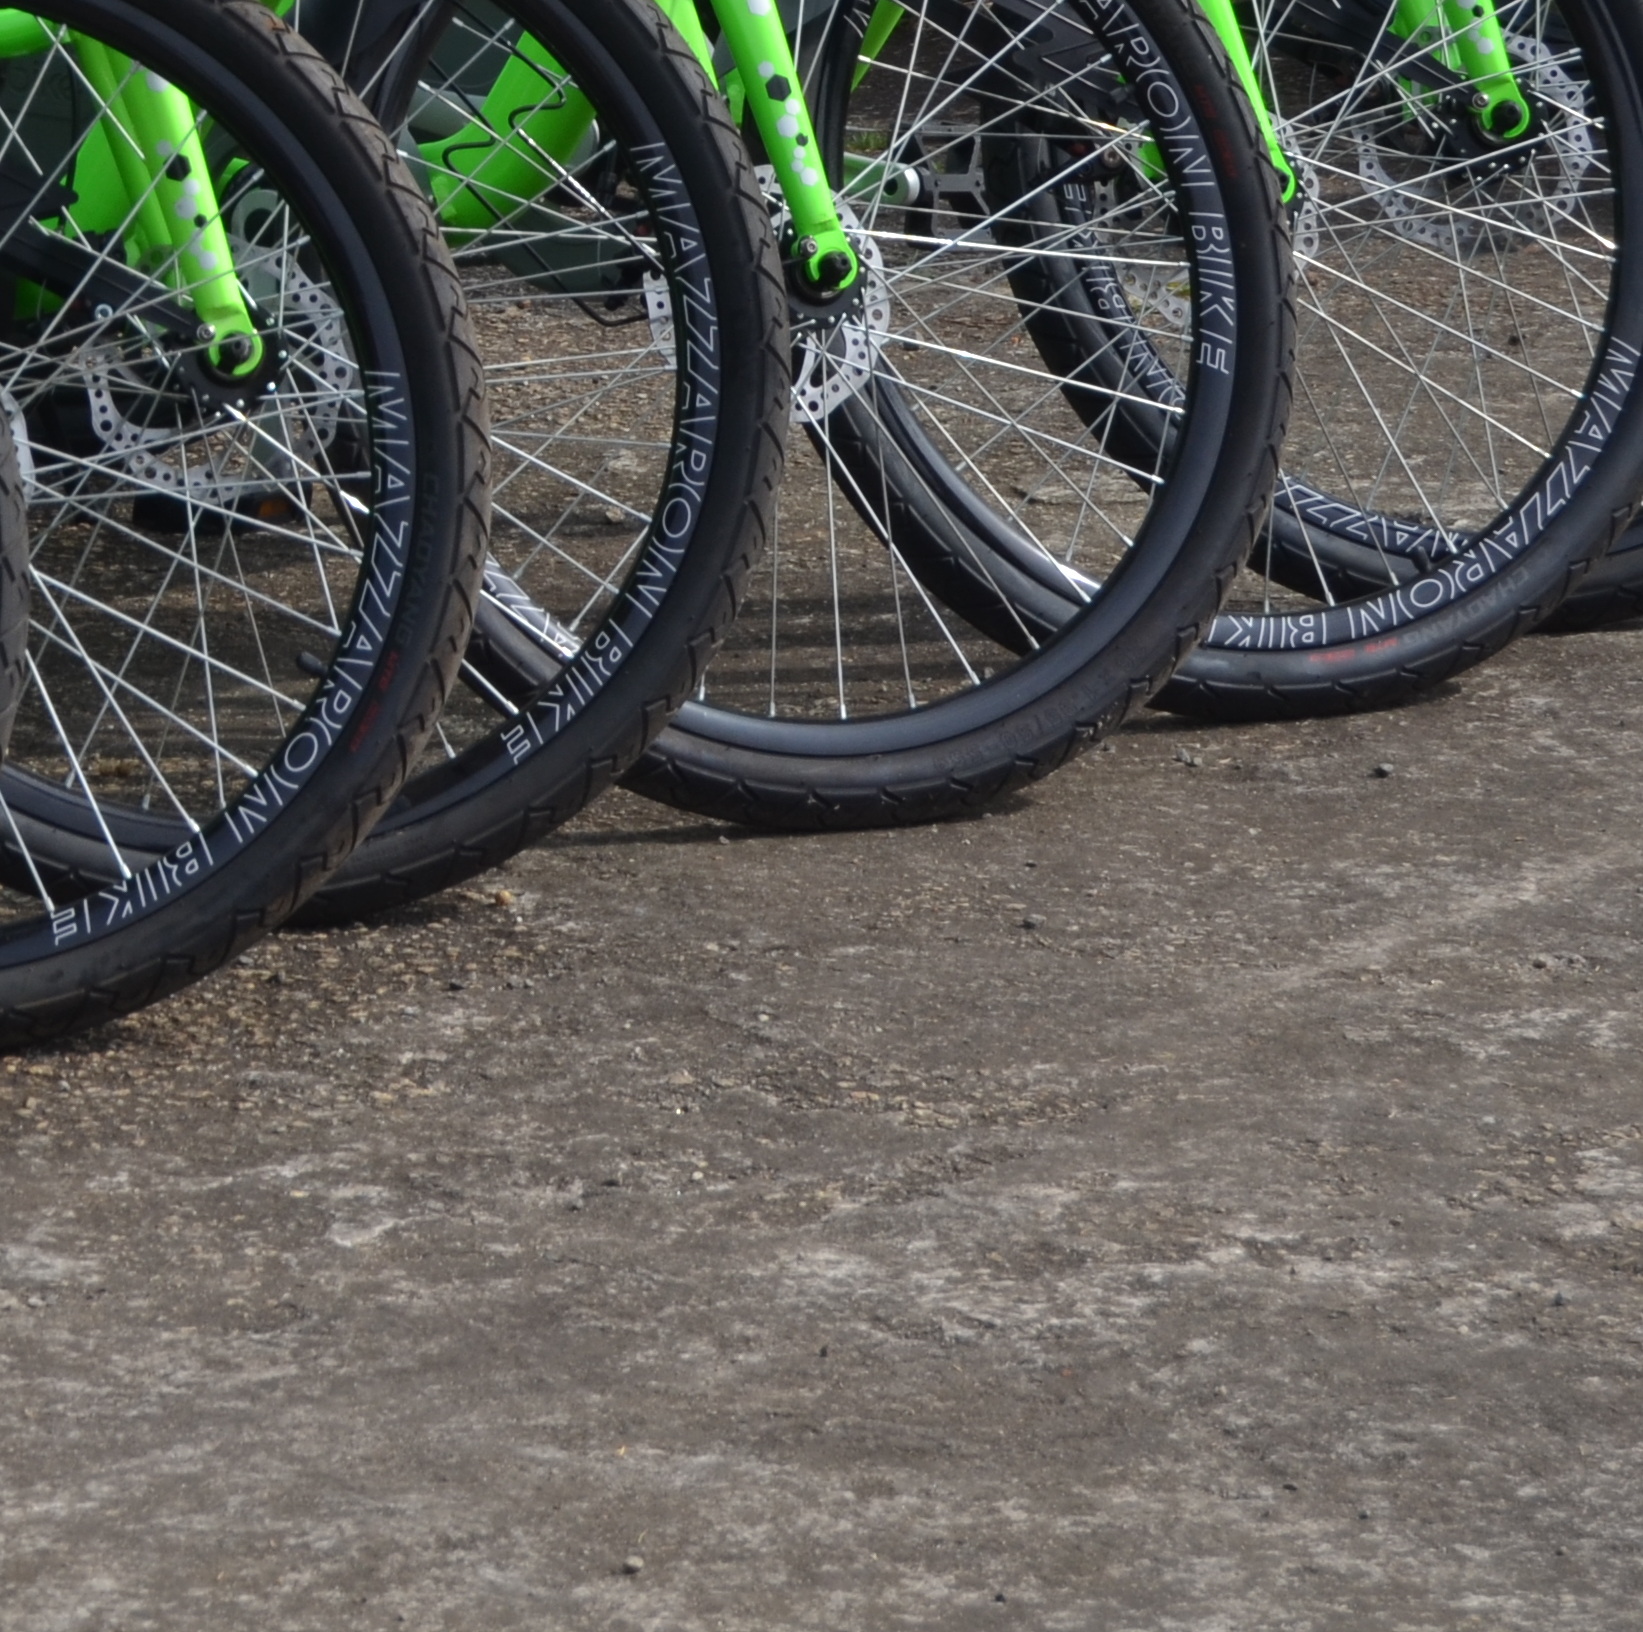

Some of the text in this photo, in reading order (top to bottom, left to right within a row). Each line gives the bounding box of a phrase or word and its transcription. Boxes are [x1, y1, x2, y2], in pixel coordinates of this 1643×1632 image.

[623, 141, 720, 619] MAZZARON
[1191, 211, 1237, 377] BIKE
[1348, 336, 1641, 639] MAZZARON
[51, 370, 412, 948] MAZZARON BIKE
[500, 618, 634, 765] BIKE
[1209, 611, 1328, 650] BIK
